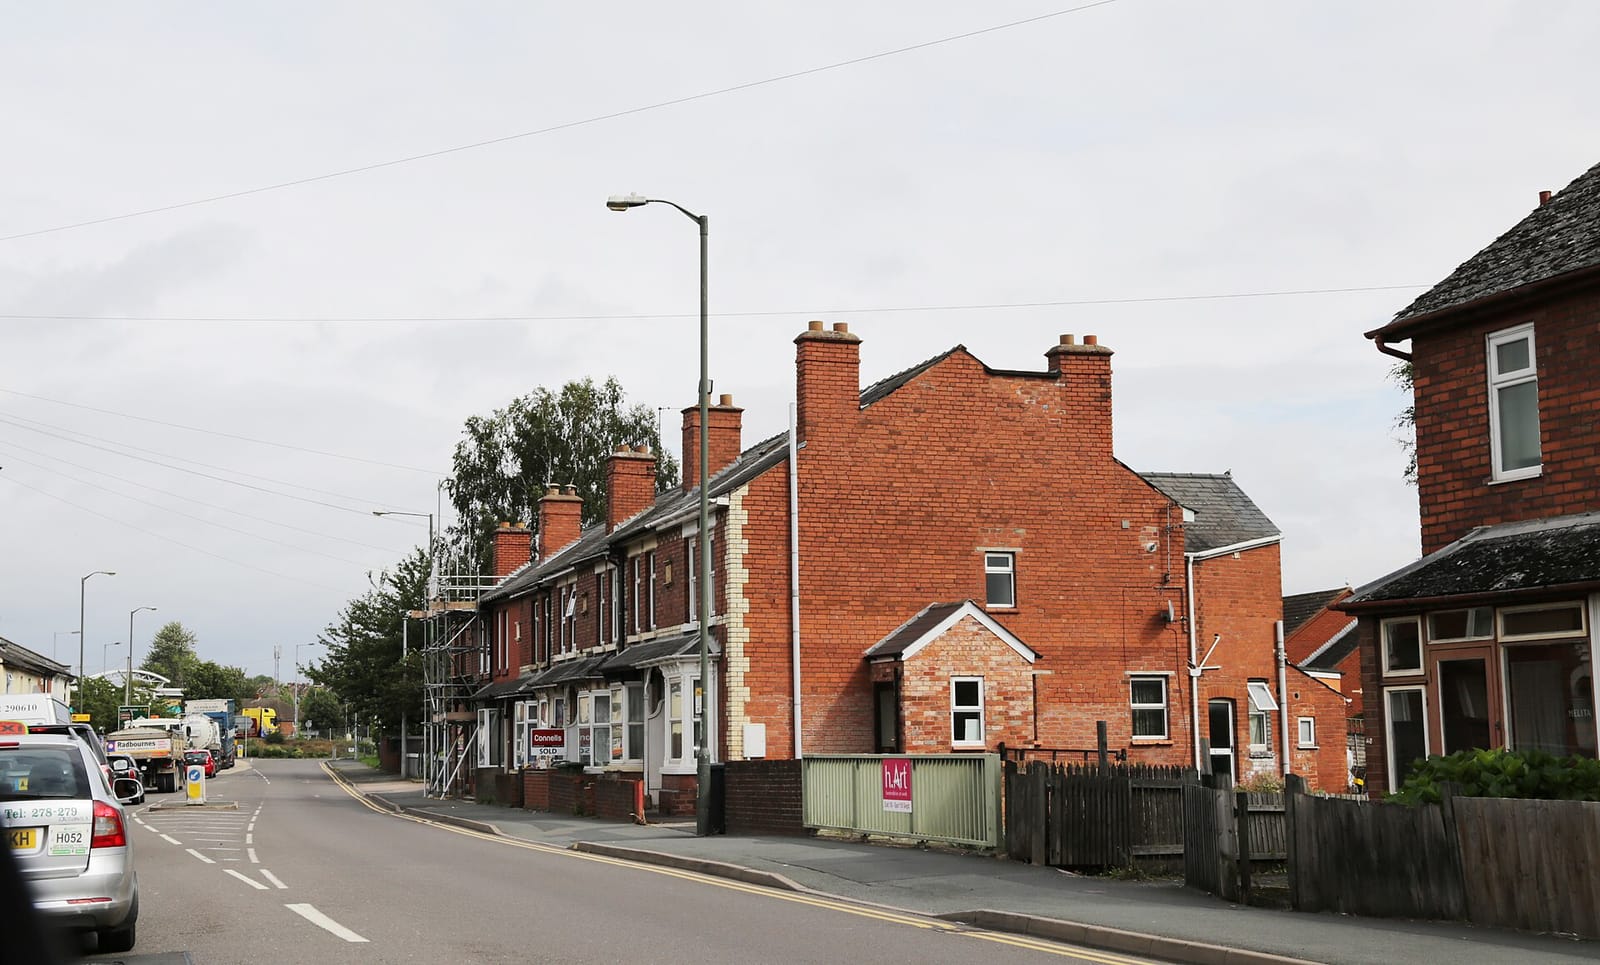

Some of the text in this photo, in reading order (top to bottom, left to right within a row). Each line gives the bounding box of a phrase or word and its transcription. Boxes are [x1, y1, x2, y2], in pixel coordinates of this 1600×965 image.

[5, 704, 38, 712] 290610
[534, 734, 562, 742] Connells
[884, 763, 908, 790] h.Art
[4, 807, 78, 819] Tel: 278-279
[56, 832, 82, 843] H052
